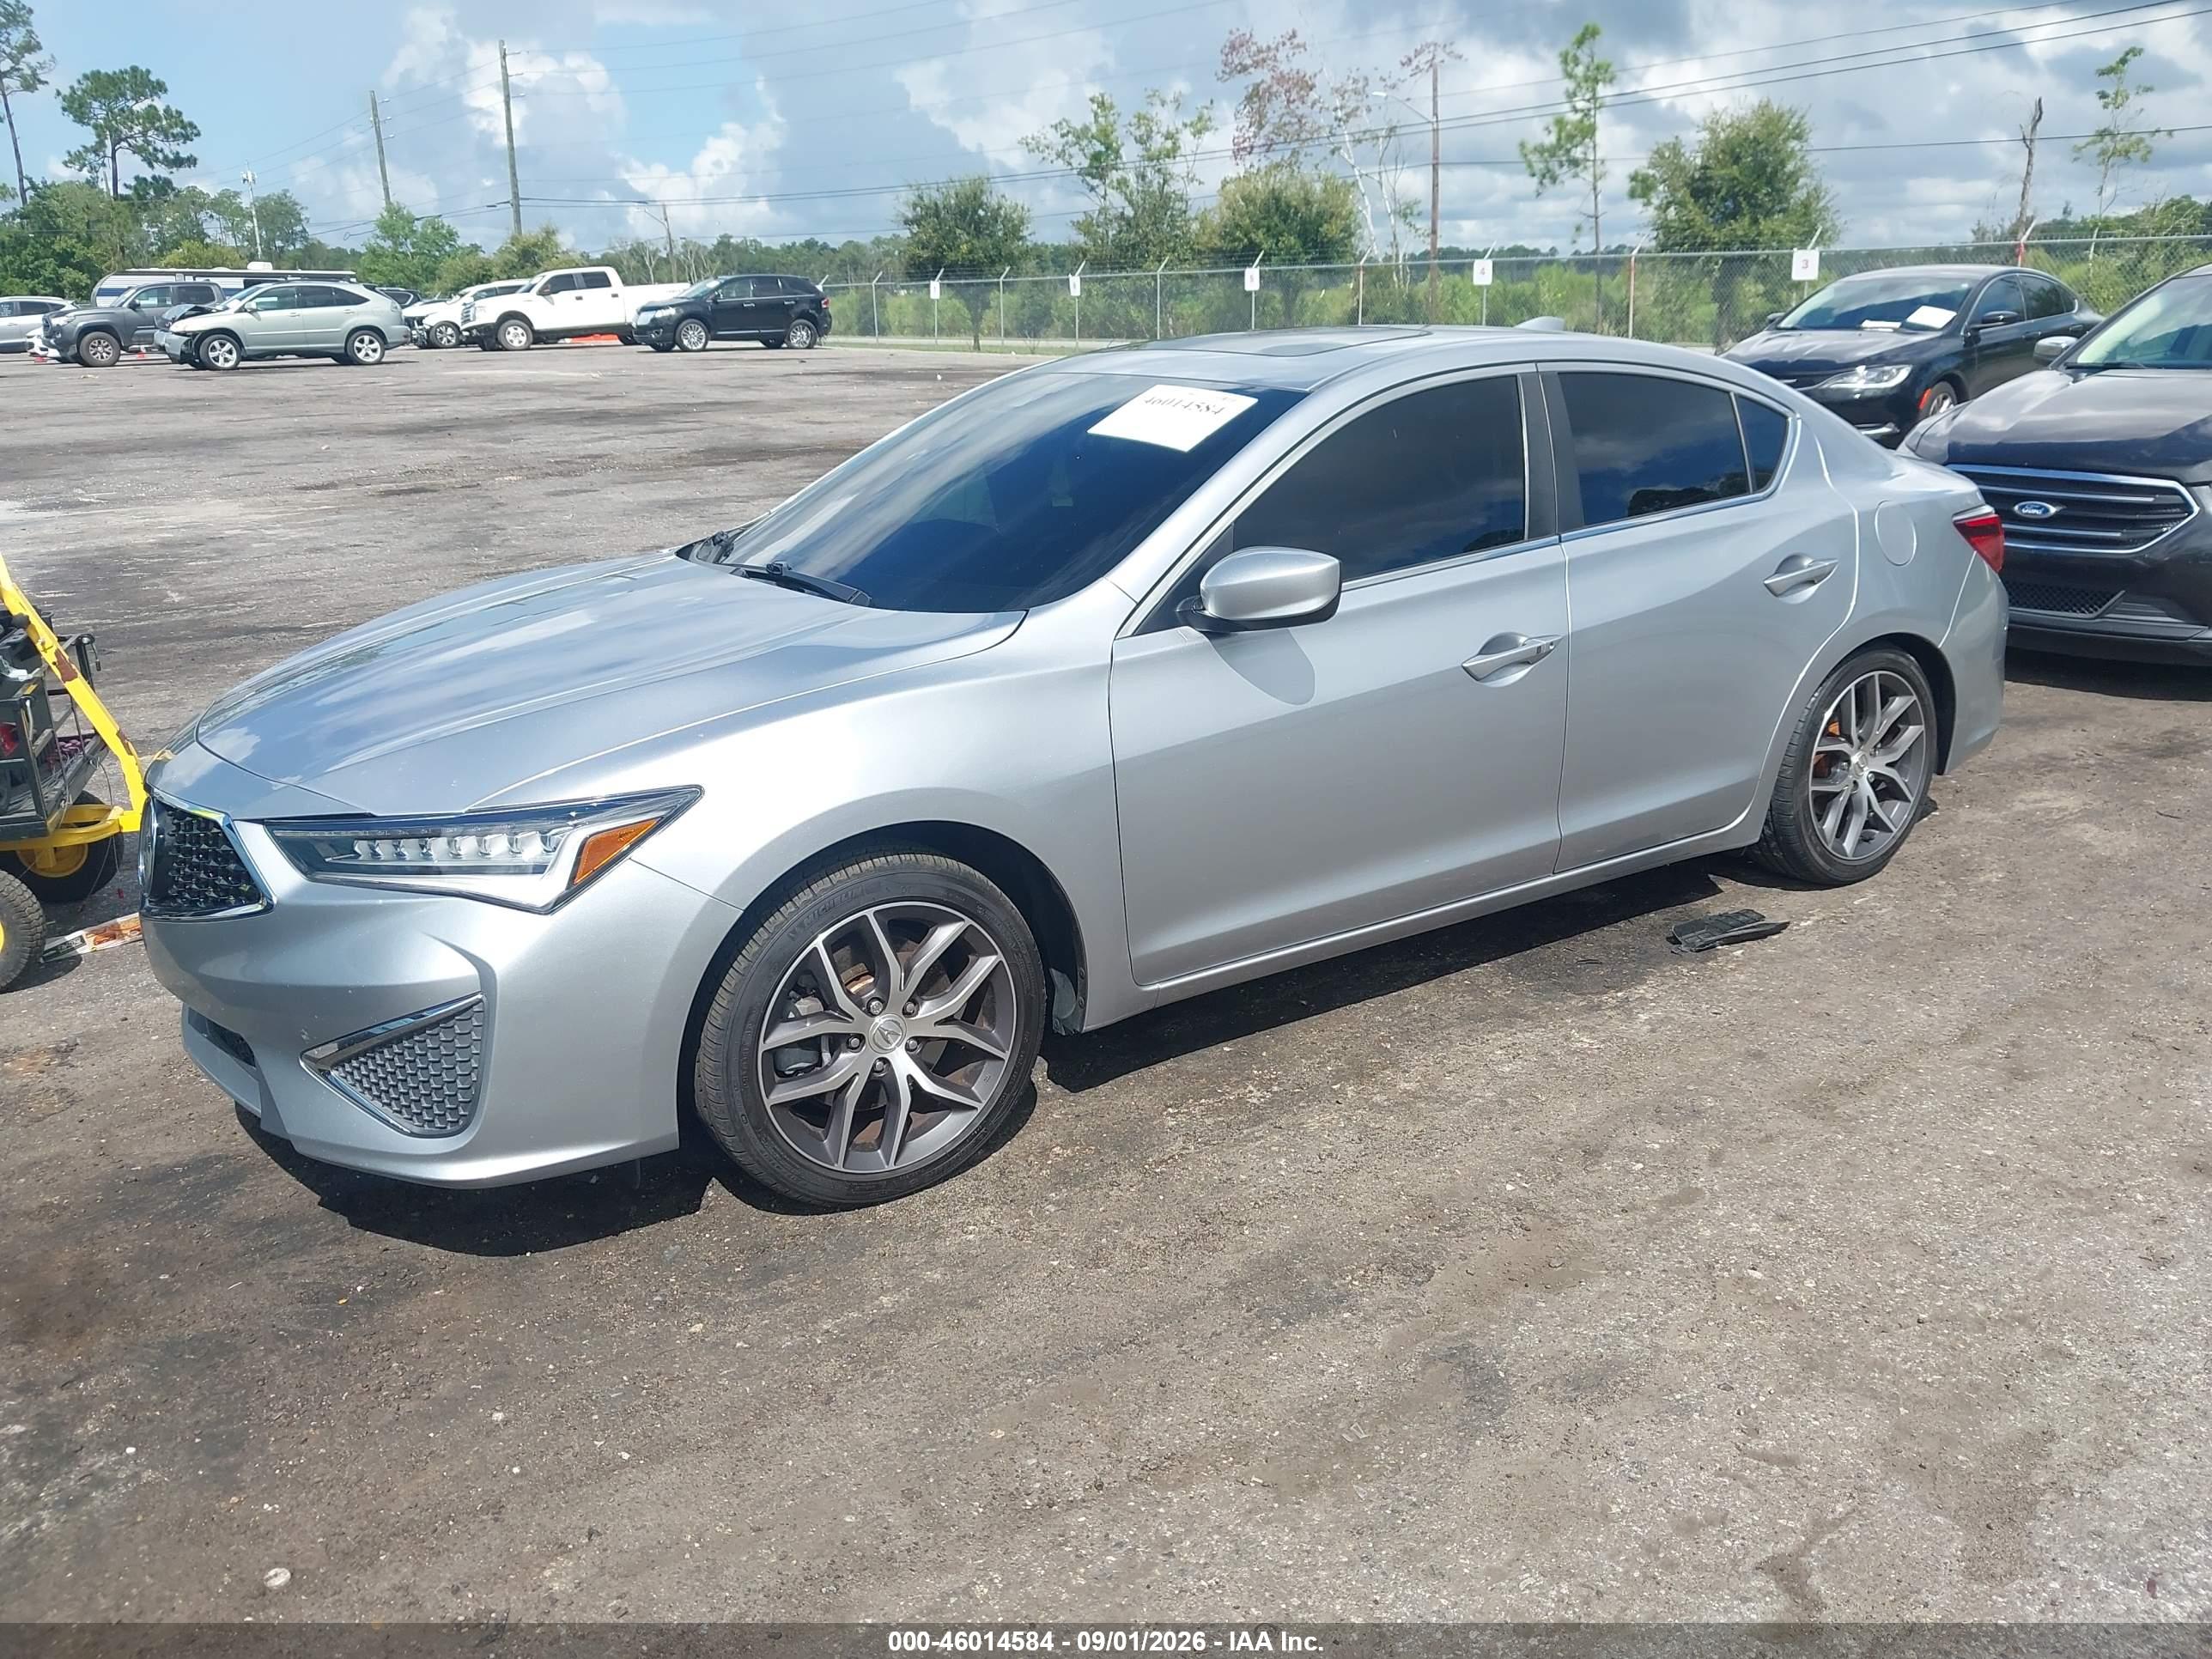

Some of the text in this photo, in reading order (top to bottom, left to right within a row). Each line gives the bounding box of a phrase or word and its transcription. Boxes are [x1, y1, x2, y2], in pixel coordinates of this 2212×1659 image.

[1801, 258, 1808, 270] 3
[1479, 267, 1486, 276] 4
[2021, 503, 2045, 515] Ford
